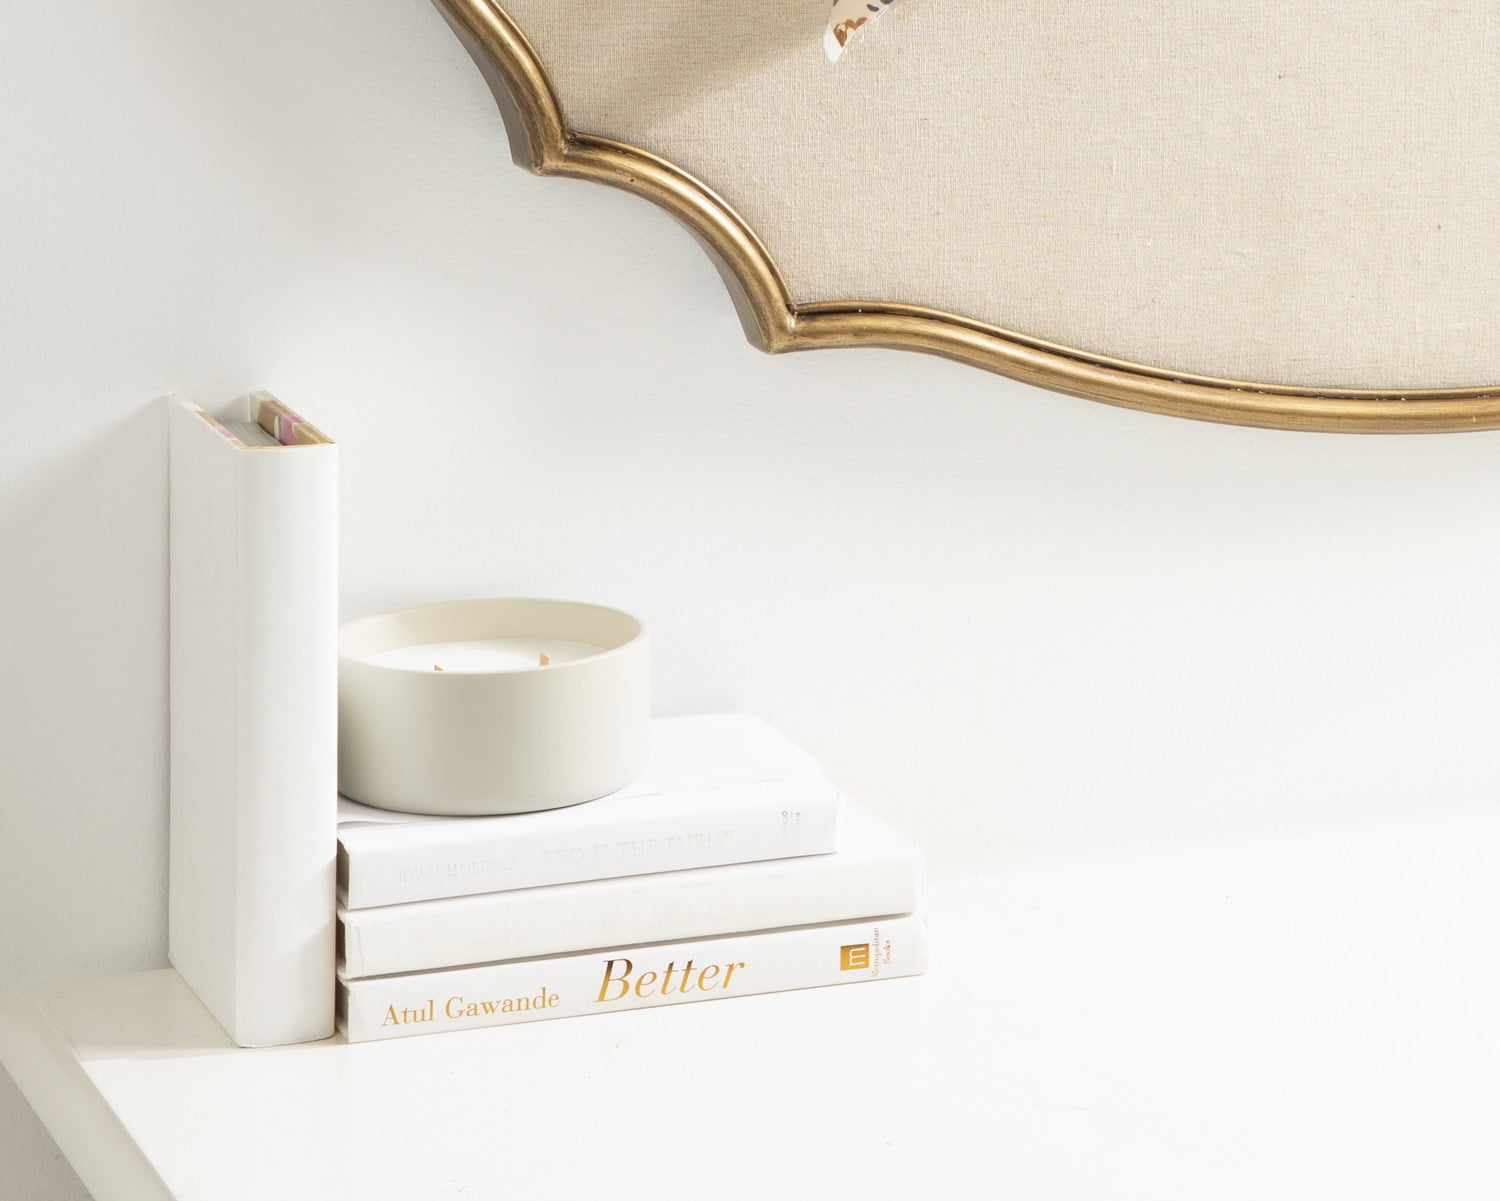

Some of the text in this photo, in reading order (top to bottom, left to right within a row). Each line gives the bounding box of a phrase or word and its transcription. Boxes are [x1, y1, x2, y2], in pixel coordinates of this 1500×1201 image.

[882, 939, 892, 965] Books
[592, 958, 745, 1003] Better
[381, 986, 560, 1027] Atul Gawande
